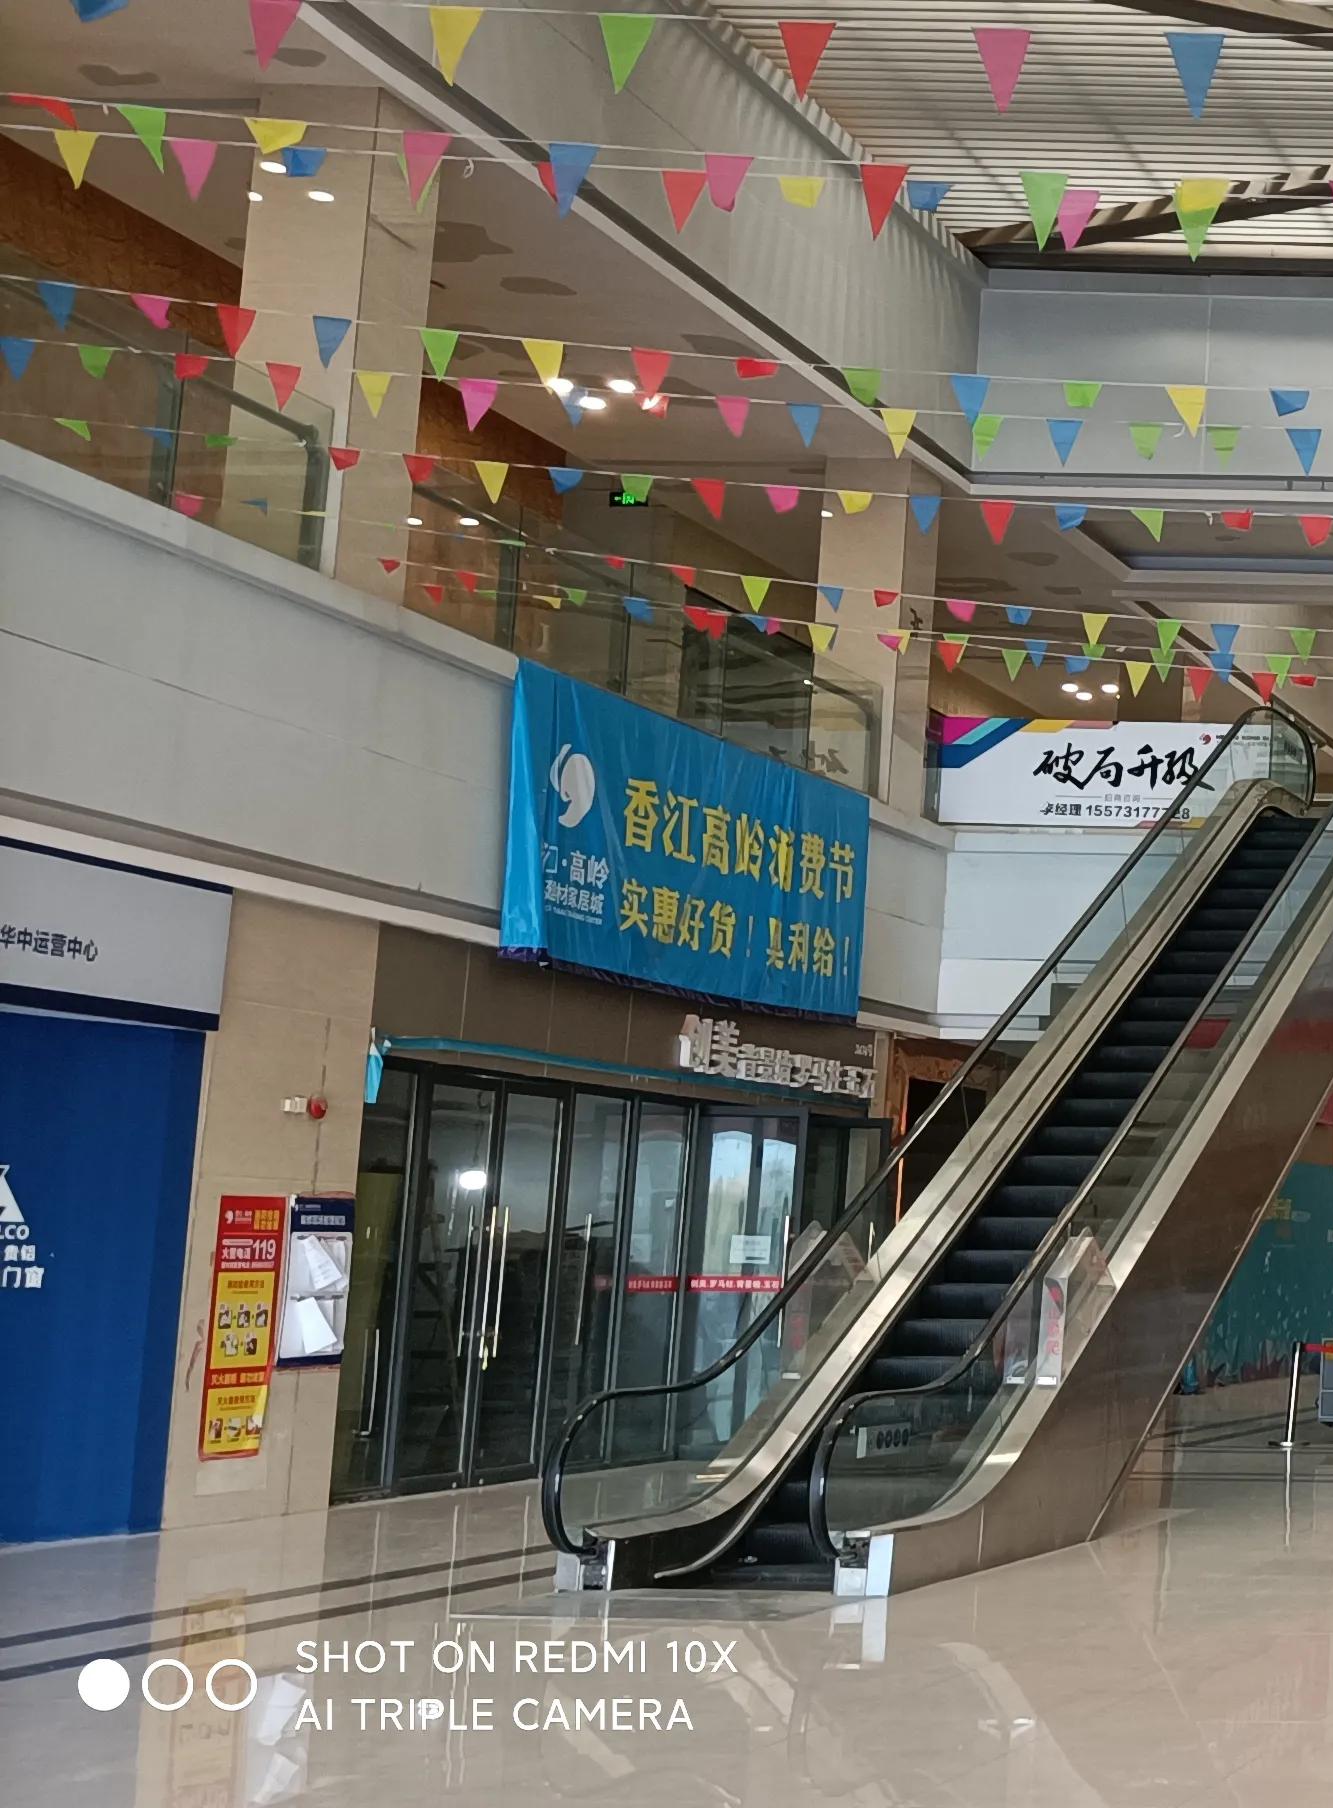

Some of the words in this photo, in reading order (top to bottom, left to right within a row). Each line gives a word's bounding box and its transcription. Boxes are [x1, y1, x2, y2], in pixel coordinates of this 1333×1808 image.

[1033, 742, 1215, 791] 破局升级
[0, 924, 98, 962] 华中运营中心
[253, 1239, 276, 1260] 119
